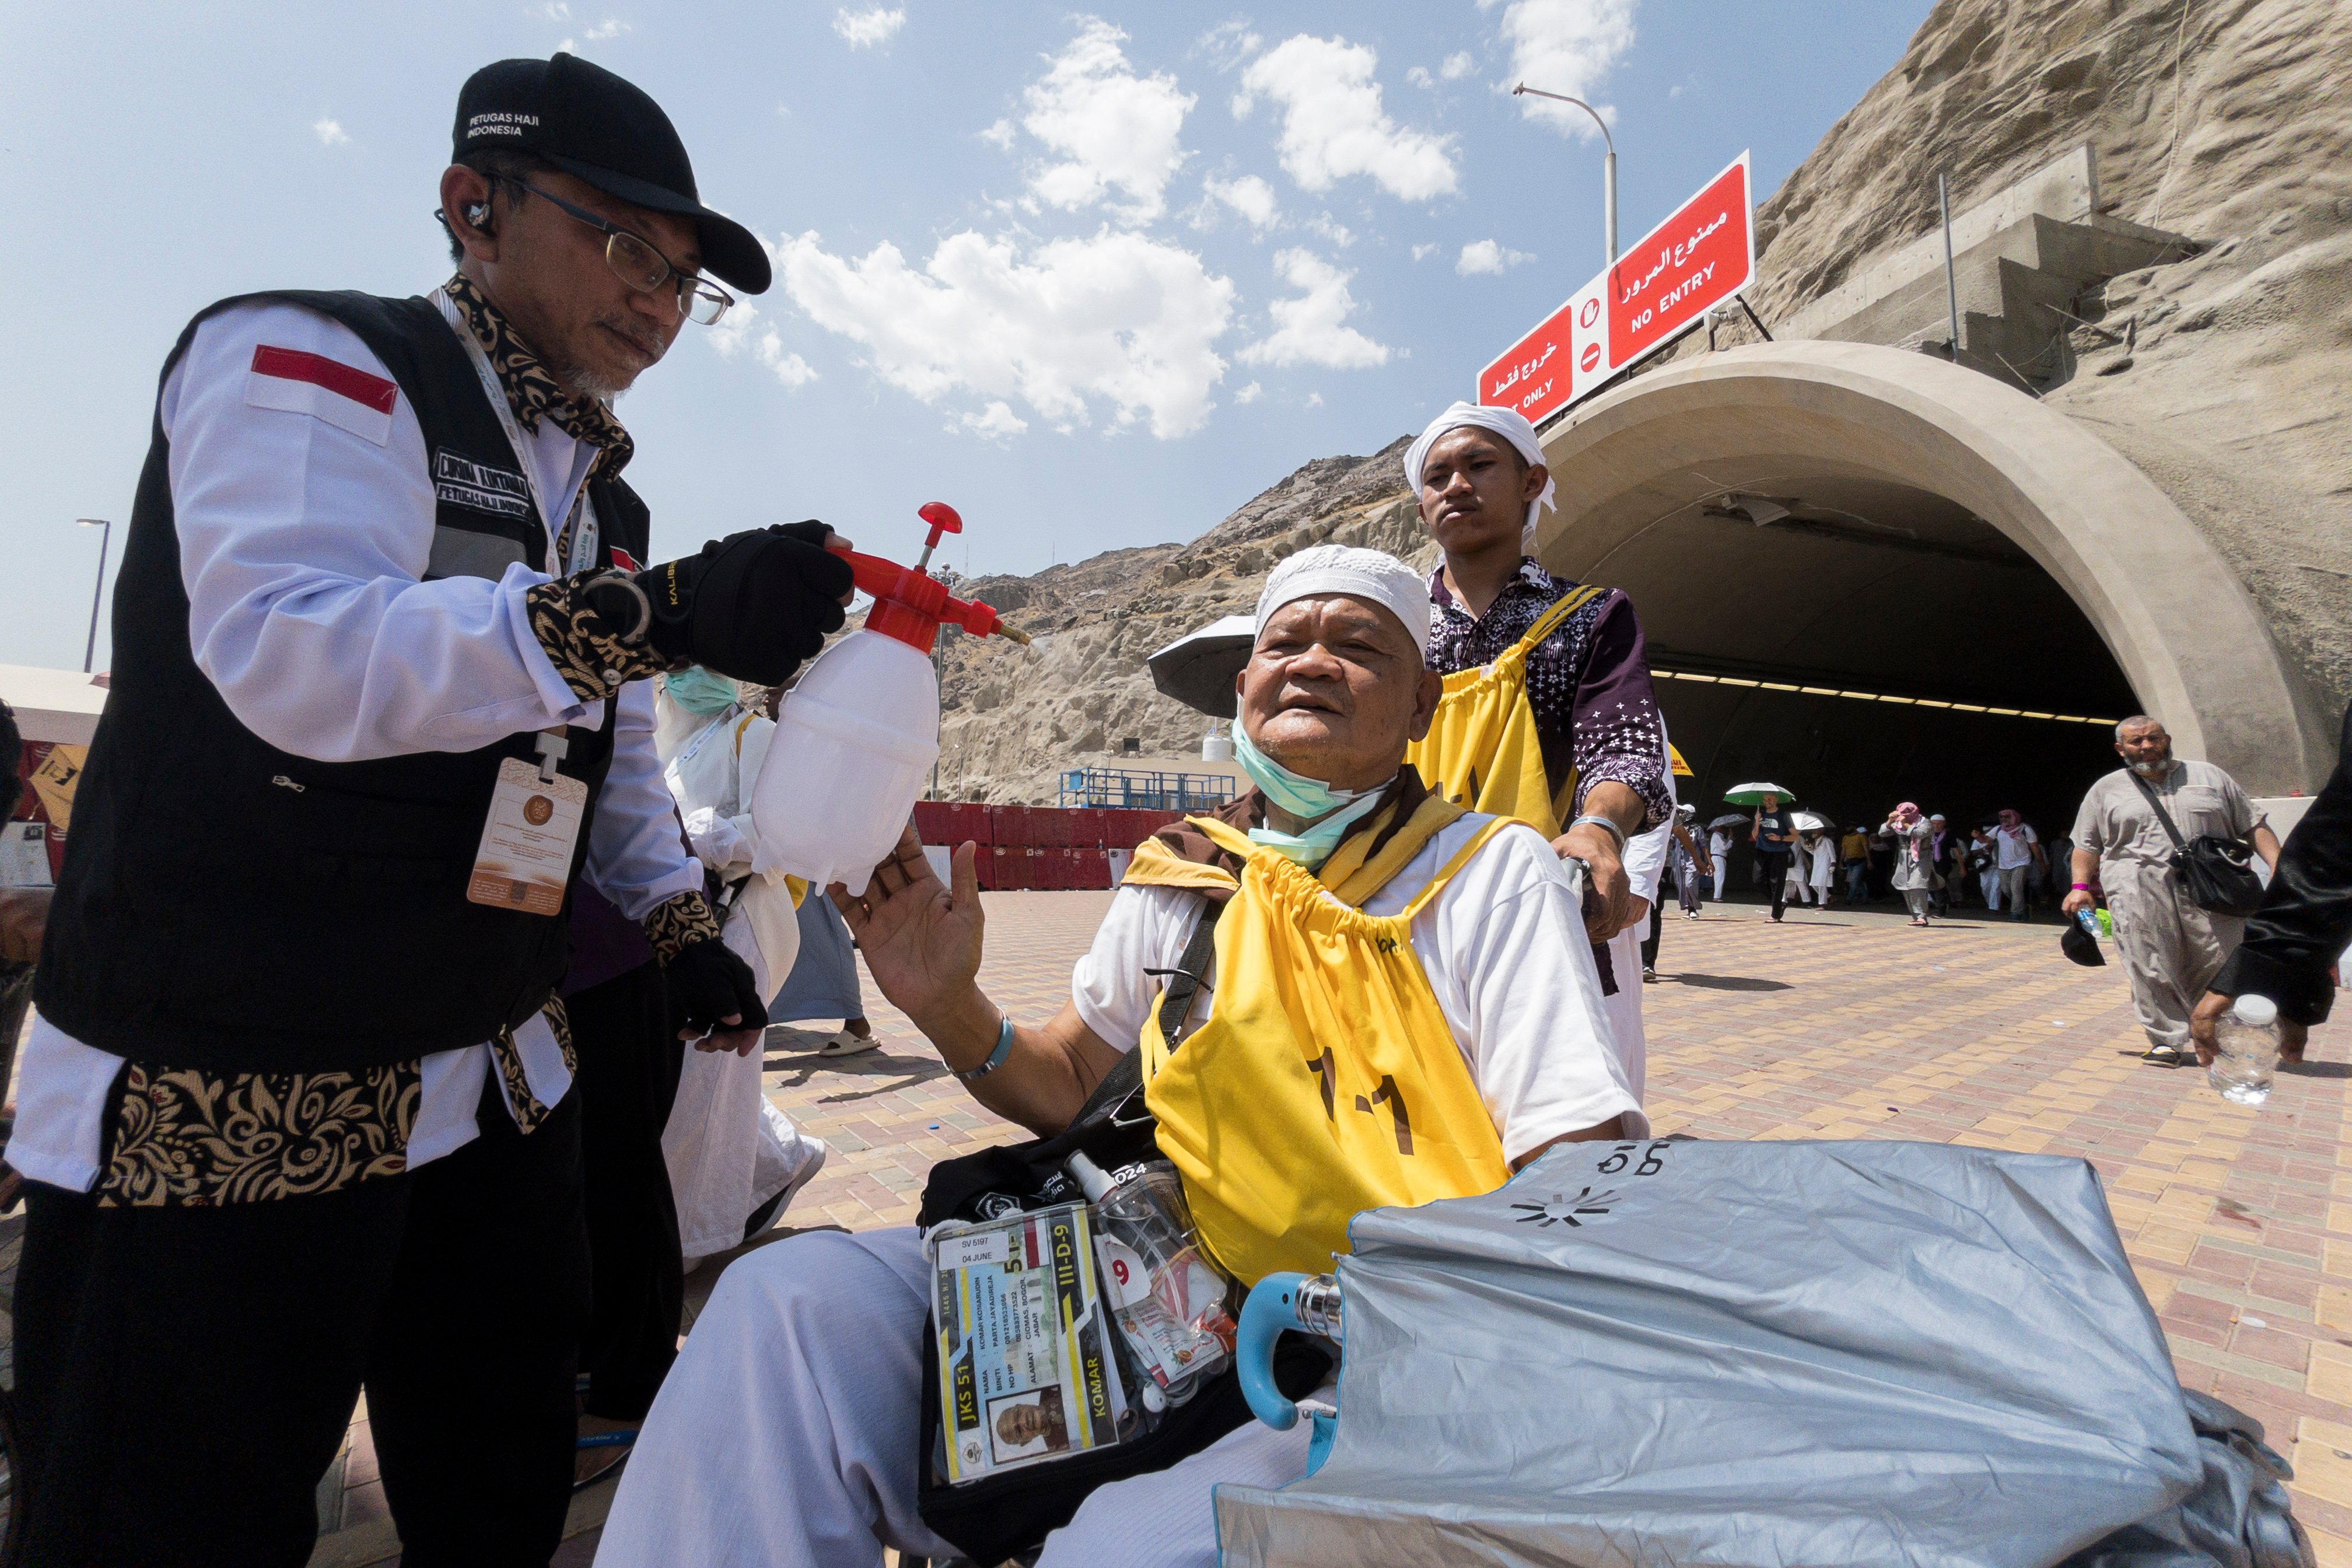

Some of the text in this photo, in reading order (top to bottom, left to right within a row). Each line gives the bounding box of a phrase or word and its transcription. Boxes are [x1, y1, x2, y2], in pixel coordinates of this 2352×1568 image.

[468, 125, 522, 139] INDONESIA
[470, 113, 539, 127] PETUGAS HAJI
[1621, 212, 1727, 304] ممنوع المرور
[1631, 261, 1716, 334] NO ENTRY
[1492, 341, 1558, 398] خروج فقط
[1522, 377, 1553, 409] ONLY
[439, 485, 481, 505] PETUGAS
[1115, 1163, 1147, 1184] 024
[963, 1252, 992, 1263] 04 JUNE
[972, 1237, 989, 1247] 5197
[1054, 1225, 1074, 1286] III-D-9
[975, 1277, 983, 1322] KOMARUDIN
[988, 1275, 996, 1320] JAYADIREJA
[1032, 1312, 1040, 1338] JABAR
[1007, 1364, 1014, 1376] HP
[1008, 1377, 1015, 1388] NO
[1027, 1352, 1037, 1384] ALAMAT
[957, 1365, 977, 1422] JKS 51
[1087, 1357, 1106, 1418] KOMAR
